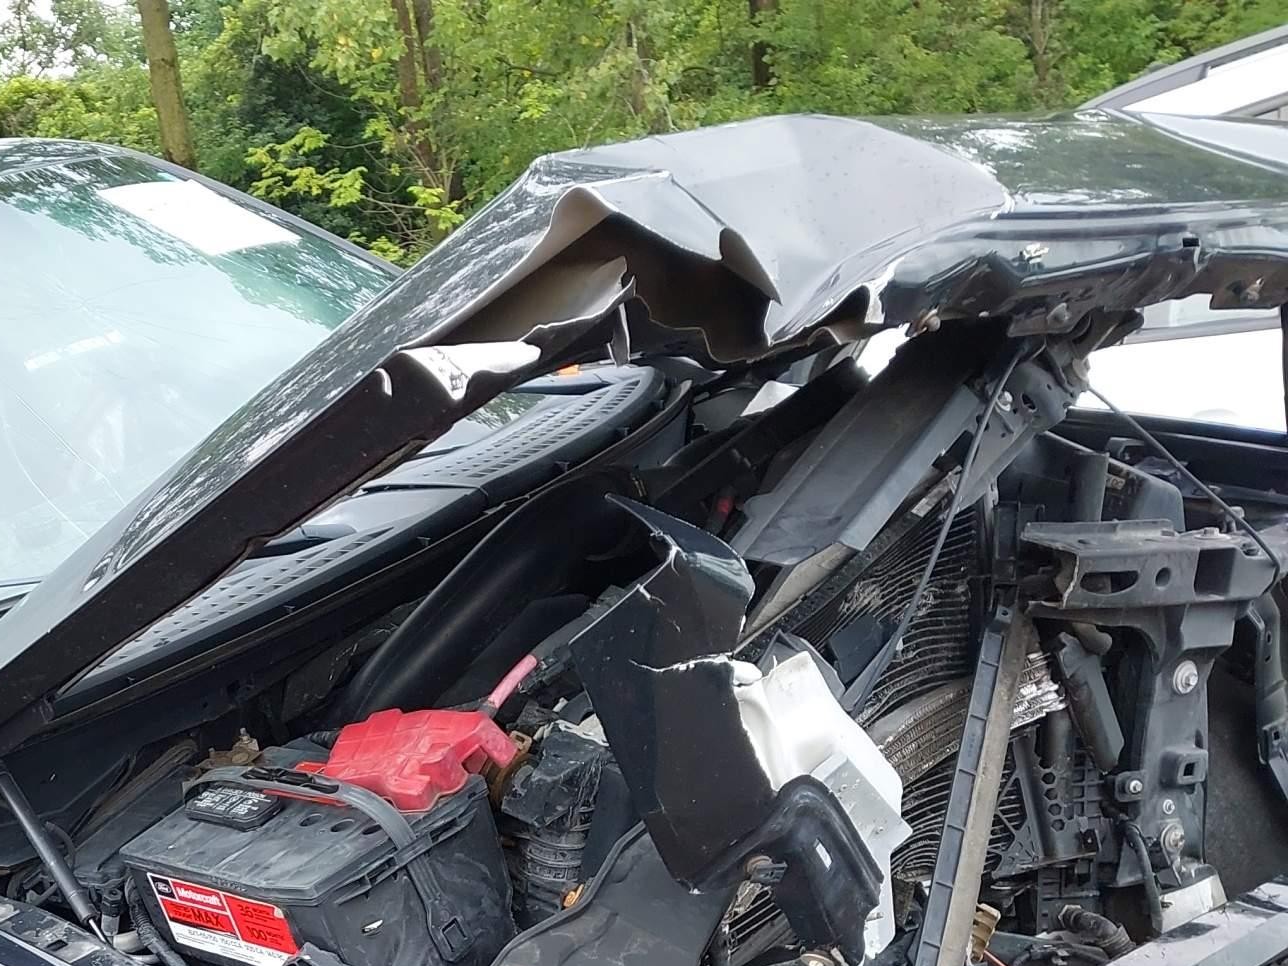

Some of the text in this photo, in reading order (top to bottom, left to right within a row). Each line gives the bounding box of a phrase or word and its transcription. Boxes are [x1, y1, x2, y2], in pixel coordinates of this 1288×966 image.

[176, 887, 222, 907] Motorcraft
[191, 907, 224, 928] MAX
[246, 926, 267, 941] 100
